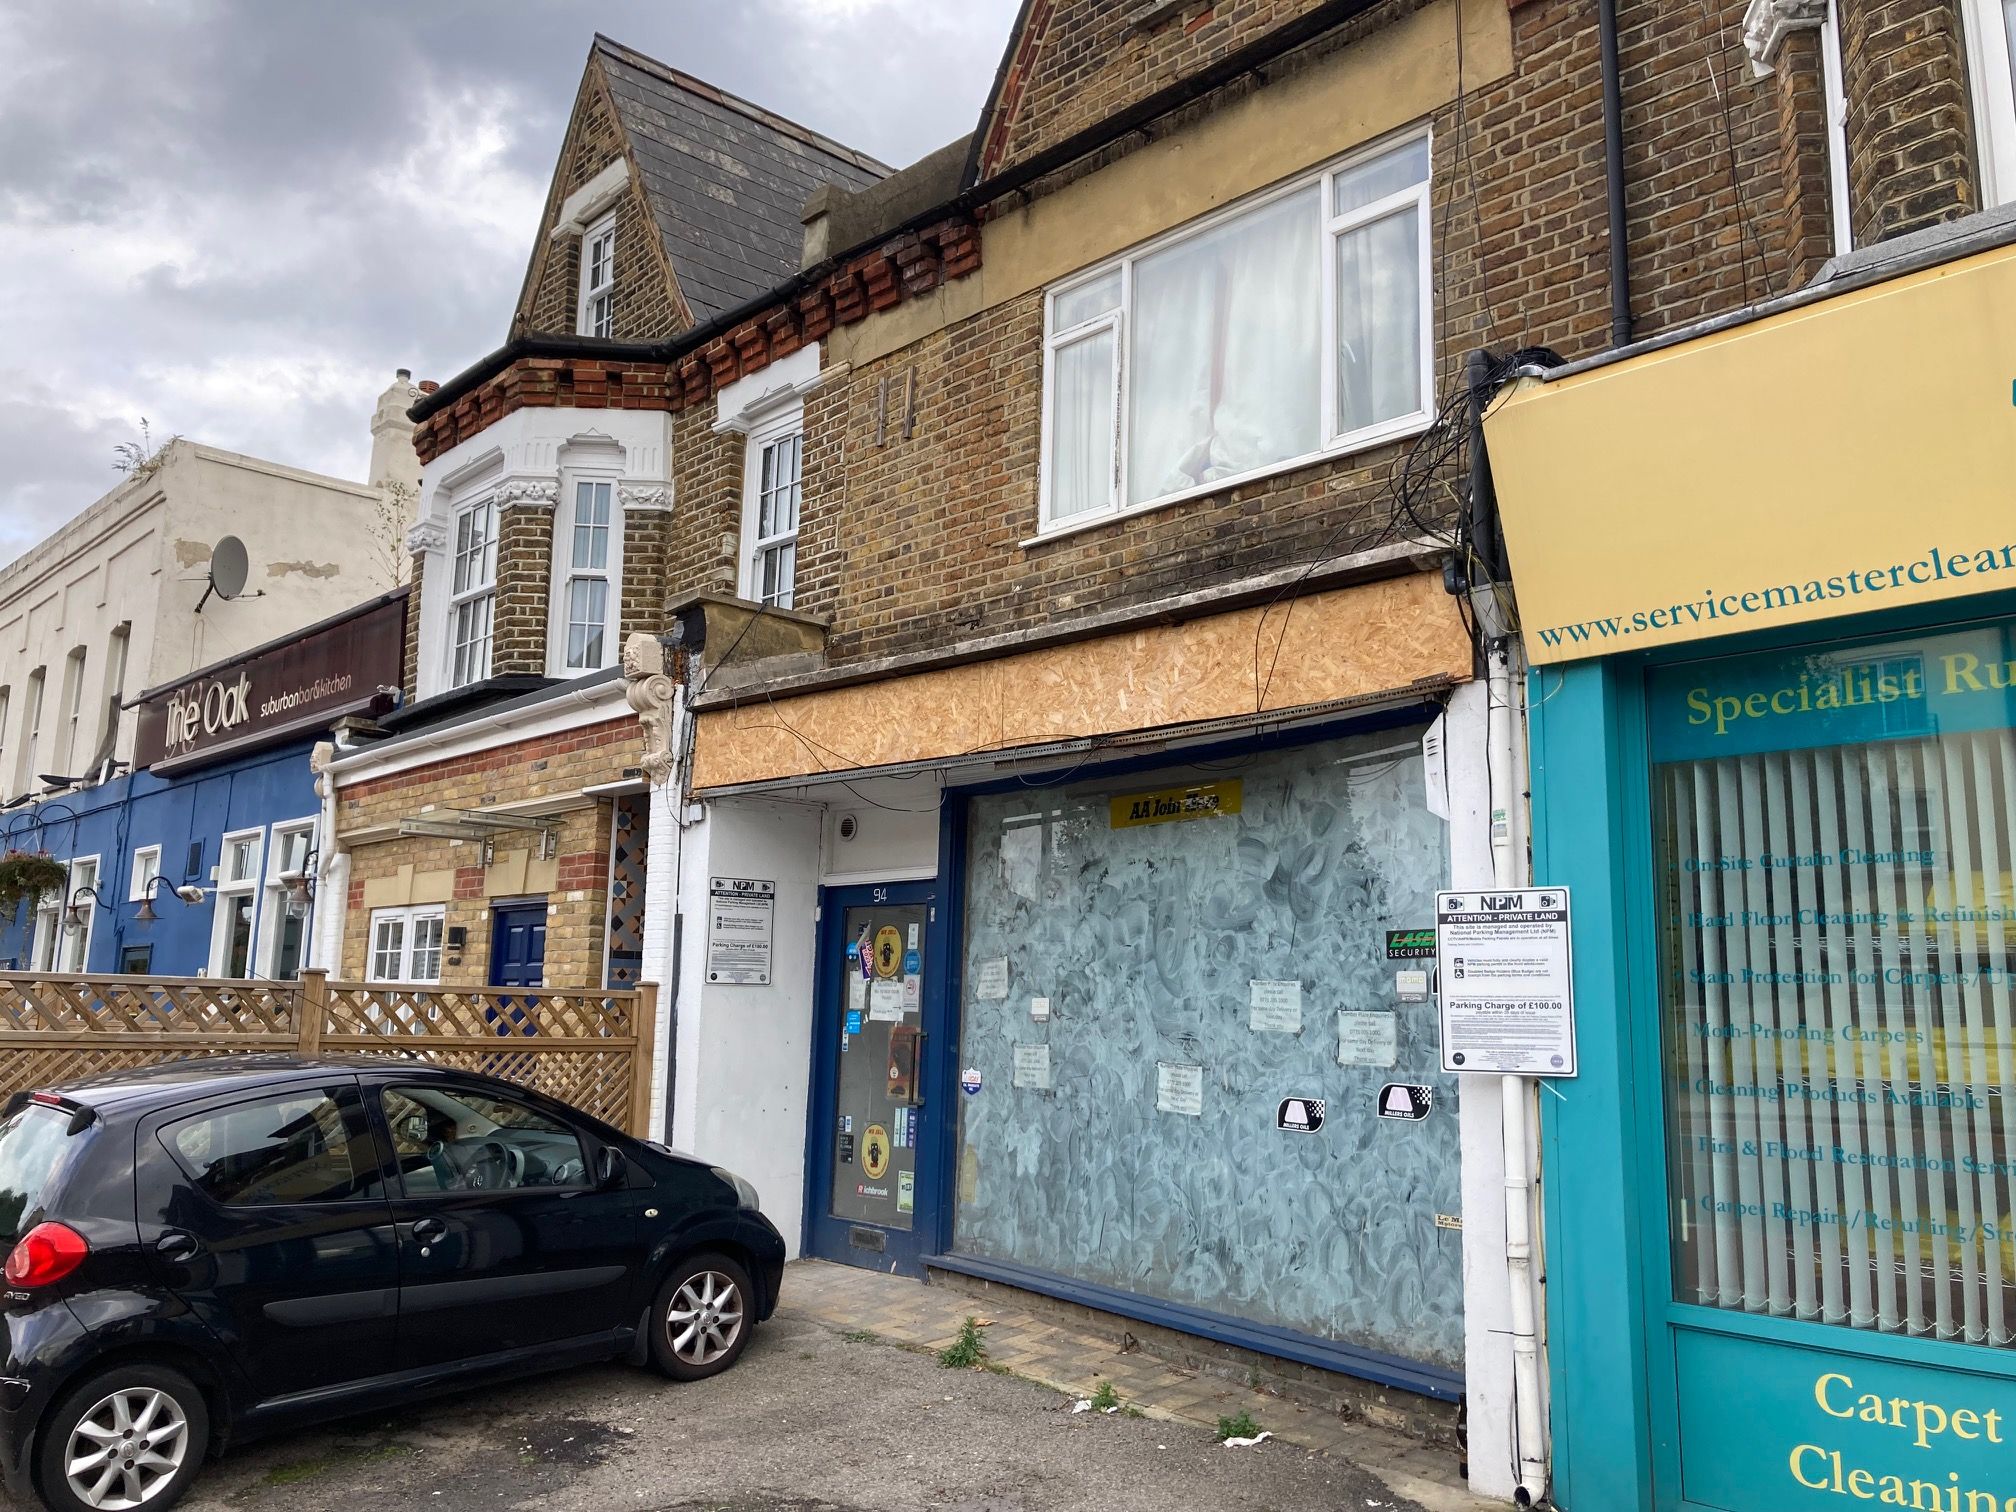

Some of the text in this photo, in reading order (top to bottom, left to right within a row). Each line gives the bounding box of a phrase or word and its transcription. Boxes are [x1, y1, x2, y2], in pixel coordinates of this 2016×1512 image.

[1687, 663, 1922, 735] Specialist
[165, 671, 252, 748] The Oak
[1129, 800, 1151, 820] AA
[1153, 796, 1180, 817] Join
[1684, 848, 1935, 873] On-Site Curtain Cleaning
[732, 880, 755, 891] NPM
[873, 887, 888, 902] 94
[1480, 894, 1523, 911] NPM
[1446, 914, 1492, 923] ATTENTION
[1499, 912, 1533, 921] PRIVATE
[1535, 912, 1558, 920] LAND
[1688, 911, 1734, 928] Hard
[1741, 911, 1792, 927] Floor
[1797, 908, 1889, 928] Cleaning
[1389, 931, 1436, 948] LASE
[1389, 948, 1436, 957] SECURITY
[1741, 967, 1842, 984] Protection
[1450, 1002, 1482, 1010] Parking
[1484, 1002, 1516, 1010] Charge
[1528, 1002, 1562, 1010] £100.00
[1693, 1022, 1923, 1047] Moth-Proofing Carpets
[1695, 1079, 1985, 1110] Cleaning Products Available
[1283, 1122, 1300, 1130] MILLERS
[1699, 1137, 1734, 1155] Fire
[1742, 1140, 1758, 1156] &
[1766, 1141, 1824, 1162] Flood
[1832, 1147, 1955, 1174] Restoration
[857, 1183, 888, 1197] Richbrook
[1701, 1195, 1766, 1218] Carpet
[1814, 1372, 2004, 1449] Carpet
[1789, 1444, 2016, 1512] Cleanin
